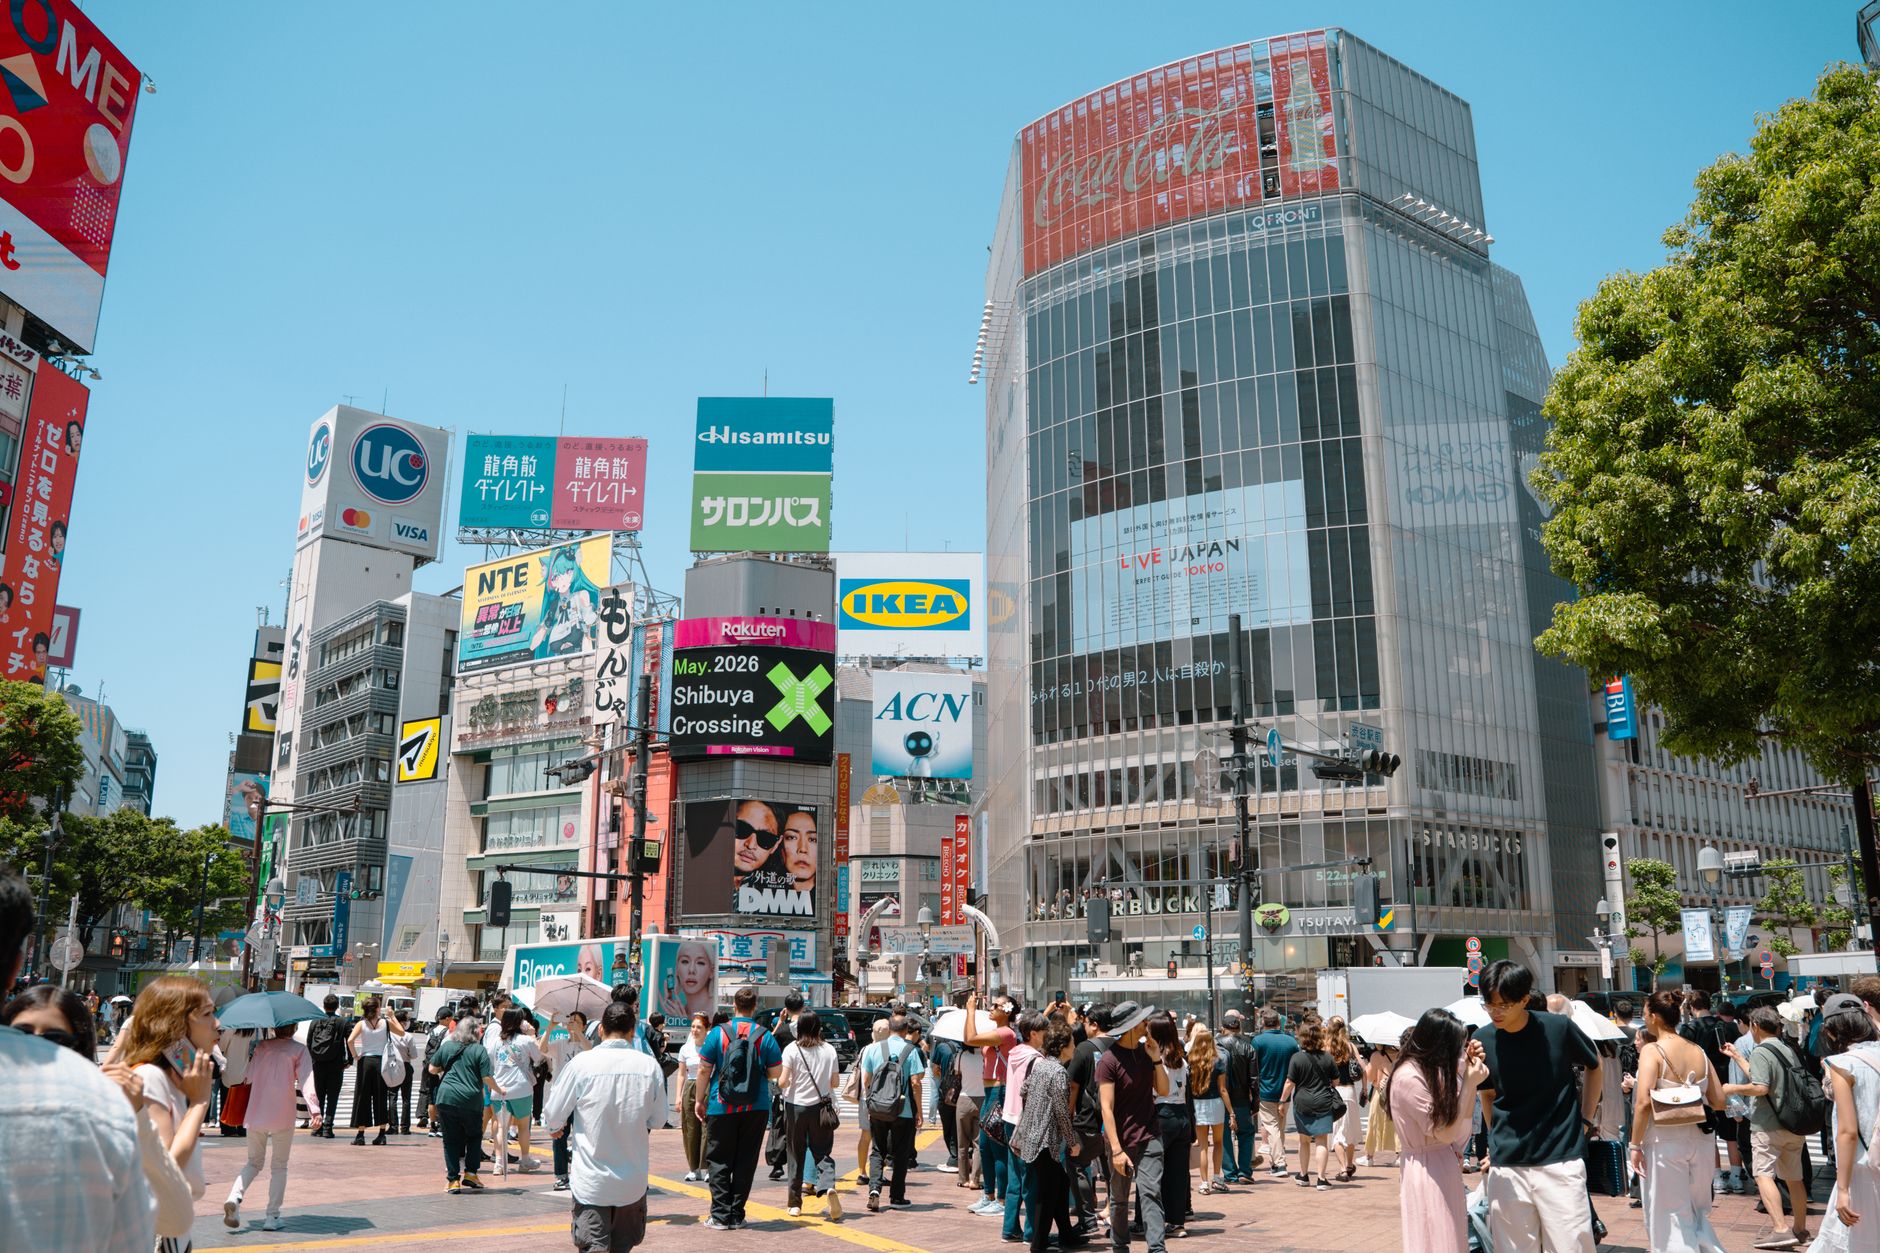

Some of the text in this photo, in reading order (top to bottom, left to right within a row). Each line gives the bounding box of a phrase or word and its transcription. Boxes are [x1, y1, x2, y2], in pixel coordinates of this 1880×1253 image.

[1252, 206, 1319, 231] QFRONT
[698, 425, 830, 445] Hisamitsu
[483, 454, 537, 478] 龍角散
[574, 456, 629, 480] 龍角散
[701, 496, 822, 527] サロンパス
[394, 522, 428, 541] VISA
[1120, 536, 1239, 570] LIVE JAPAN
[478, 562, 529, 597] NTE
[1135, 562, 1225, 585] ERFECT GUDE TOKYO
[853, 593, 960, 614] IKEA
[721, 621, 786, 639] Rakuten
[595, 588, 630, 718] もんじゃ
[674, 655, 759, 676] May. 2026
[674, 685, 754, 707] Shibuya
[874, 691, 970, 723] ACN
[673, 714, 765, 737] Crossing
[281, 741, 291, 757] 7F
[418, 732, 437, 767] matsukiyo
[956, 821, 968, 879] カラオケ
[755, 870, 798, 885] 外道の歌
[862, 871, 899, 880] クリニック
[871, 862, 899, 871] れいわ
[738, 886, 813, 915] DMM
[942, 882, 951, 922] カラオ
[1065, 896, 1219, 919] SRBUCK
[519, 958, 565, 989] Blanc
[664, 1013, 688, 1027] lanc
